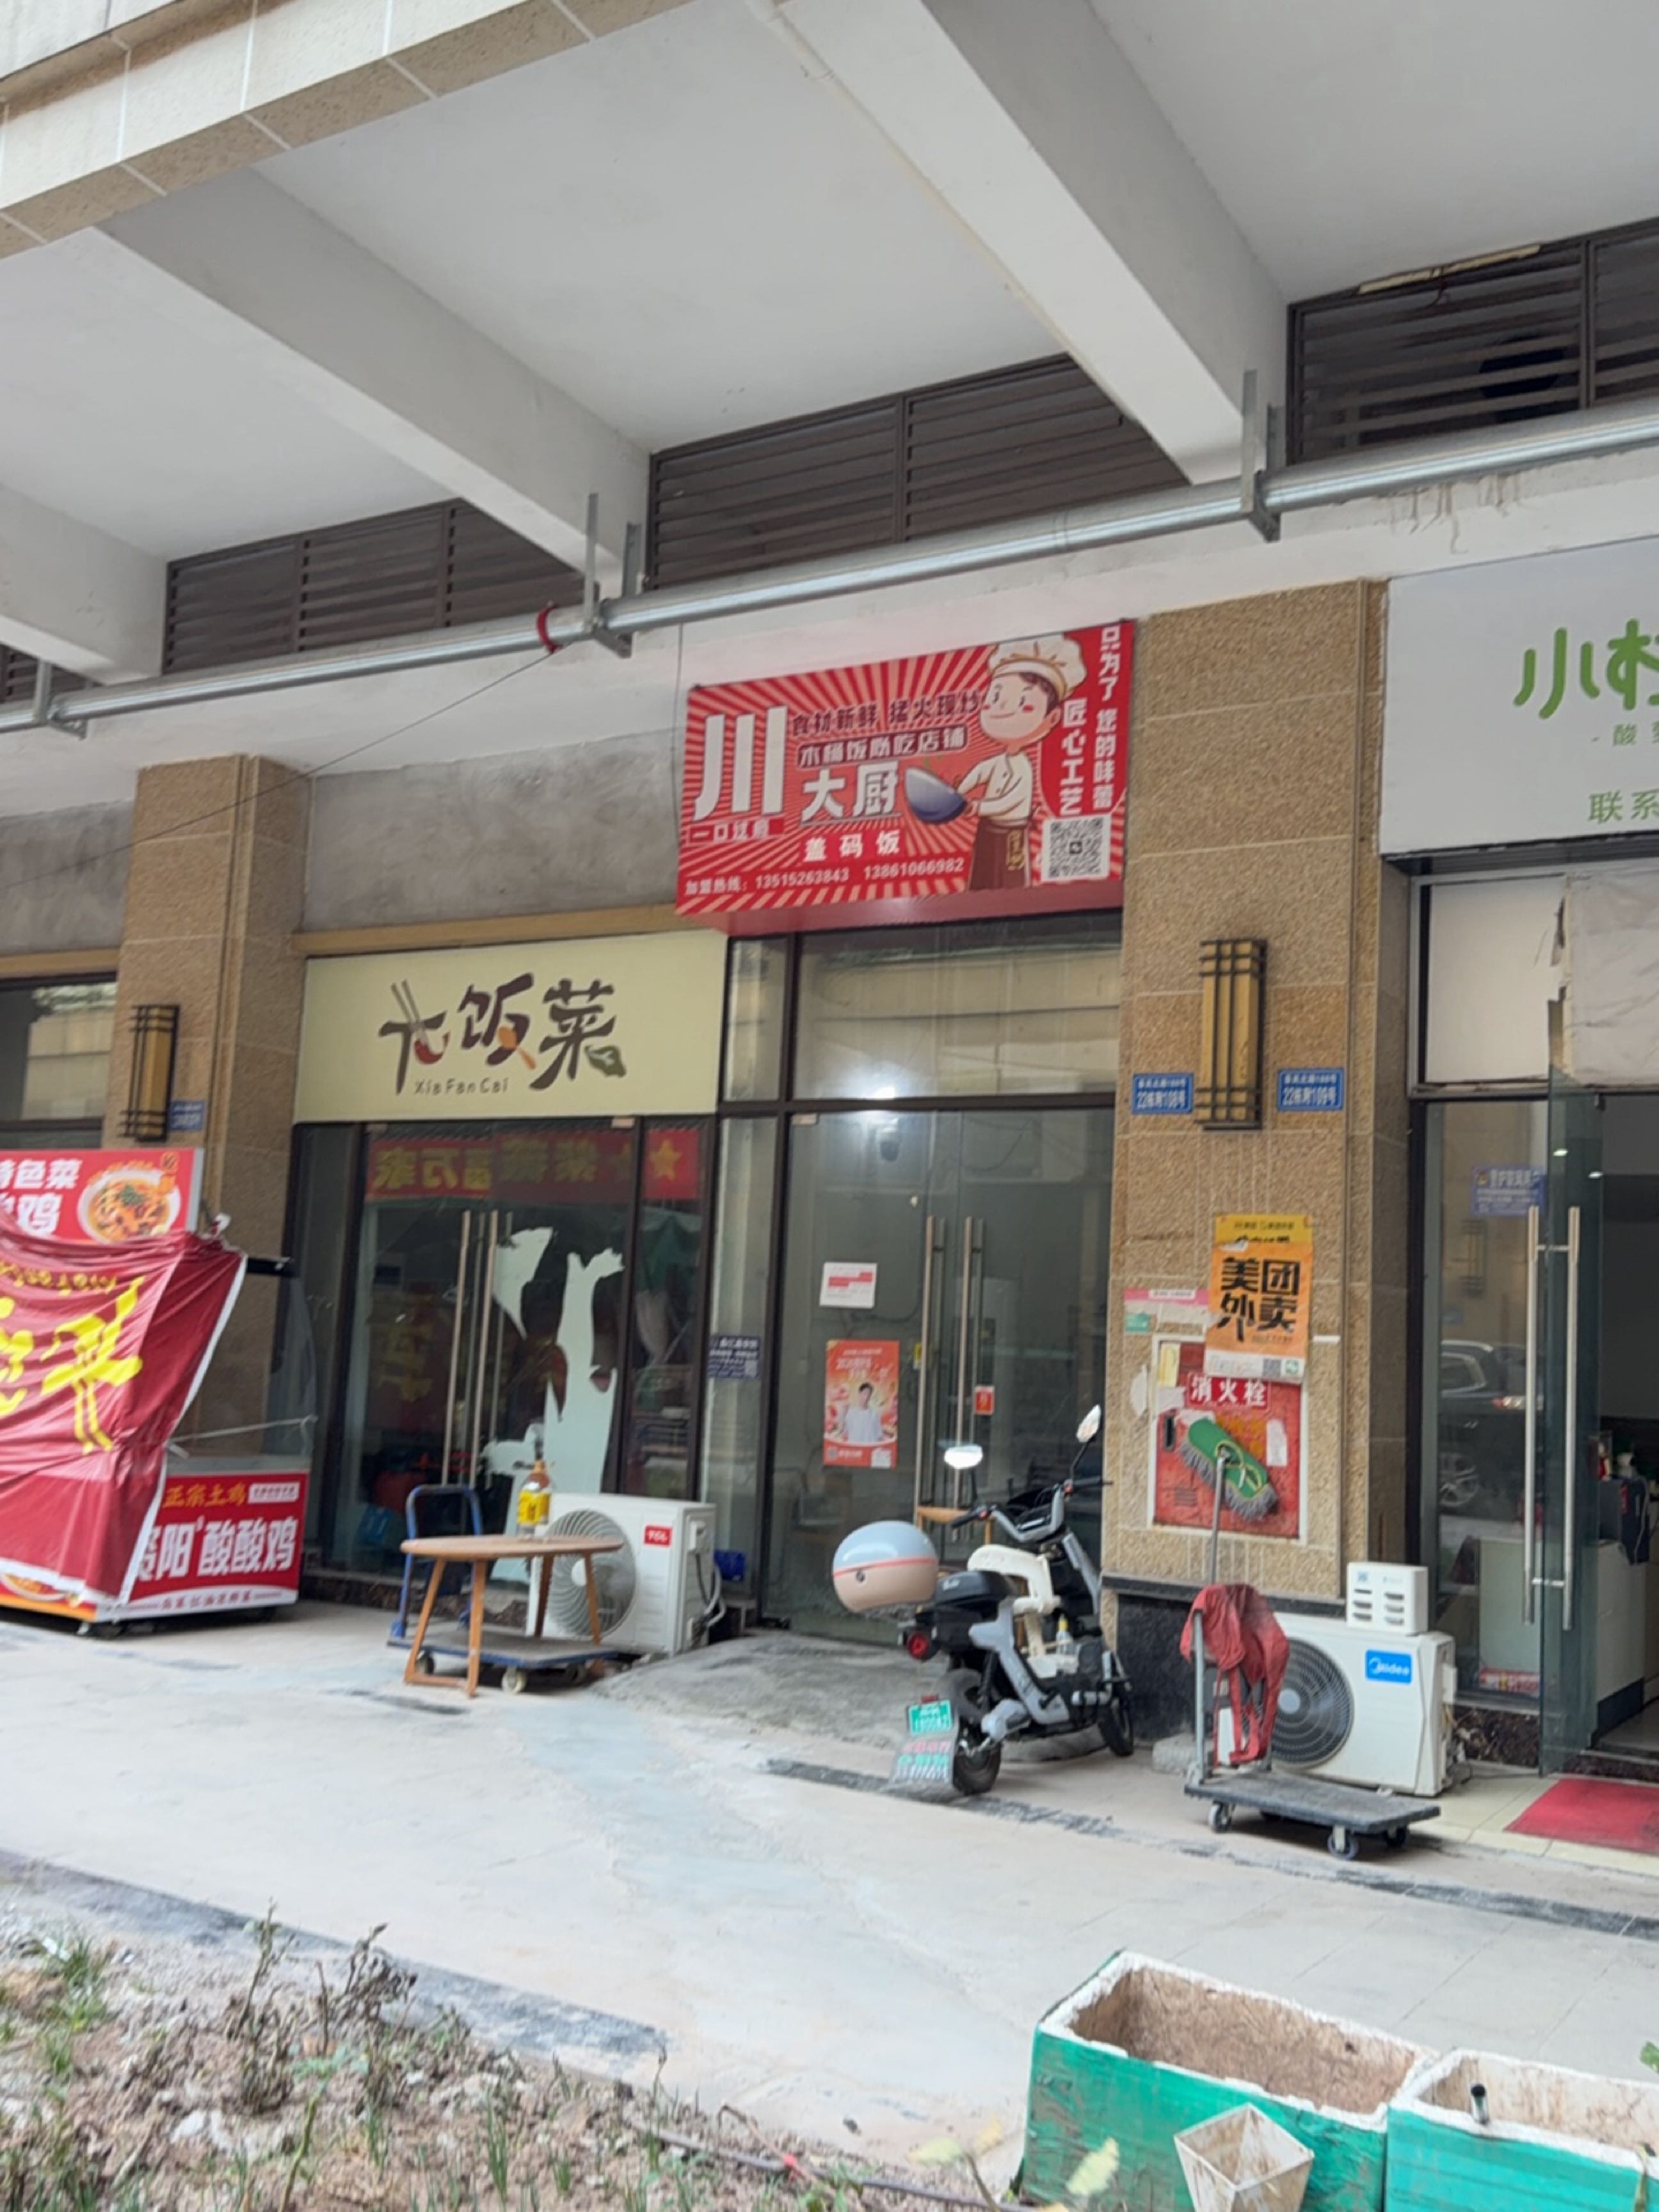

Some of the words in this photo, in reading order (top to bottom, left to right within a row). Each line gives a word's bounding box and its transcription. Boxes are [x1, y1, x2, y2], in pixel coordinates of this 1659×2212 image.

[693, 705, 788, 822] 川
[1059, 698, 1087, 817] 匠心工艺
[801, 760, 899, 823] 大厨
[1221, 1256, 1301, 1295] 美团
[1217, 1293, 1297, 1342] 外卖
[1191, 1375, 1267, 1407] 消火栓
[1369, 1658, 1410, 1676] Midea
